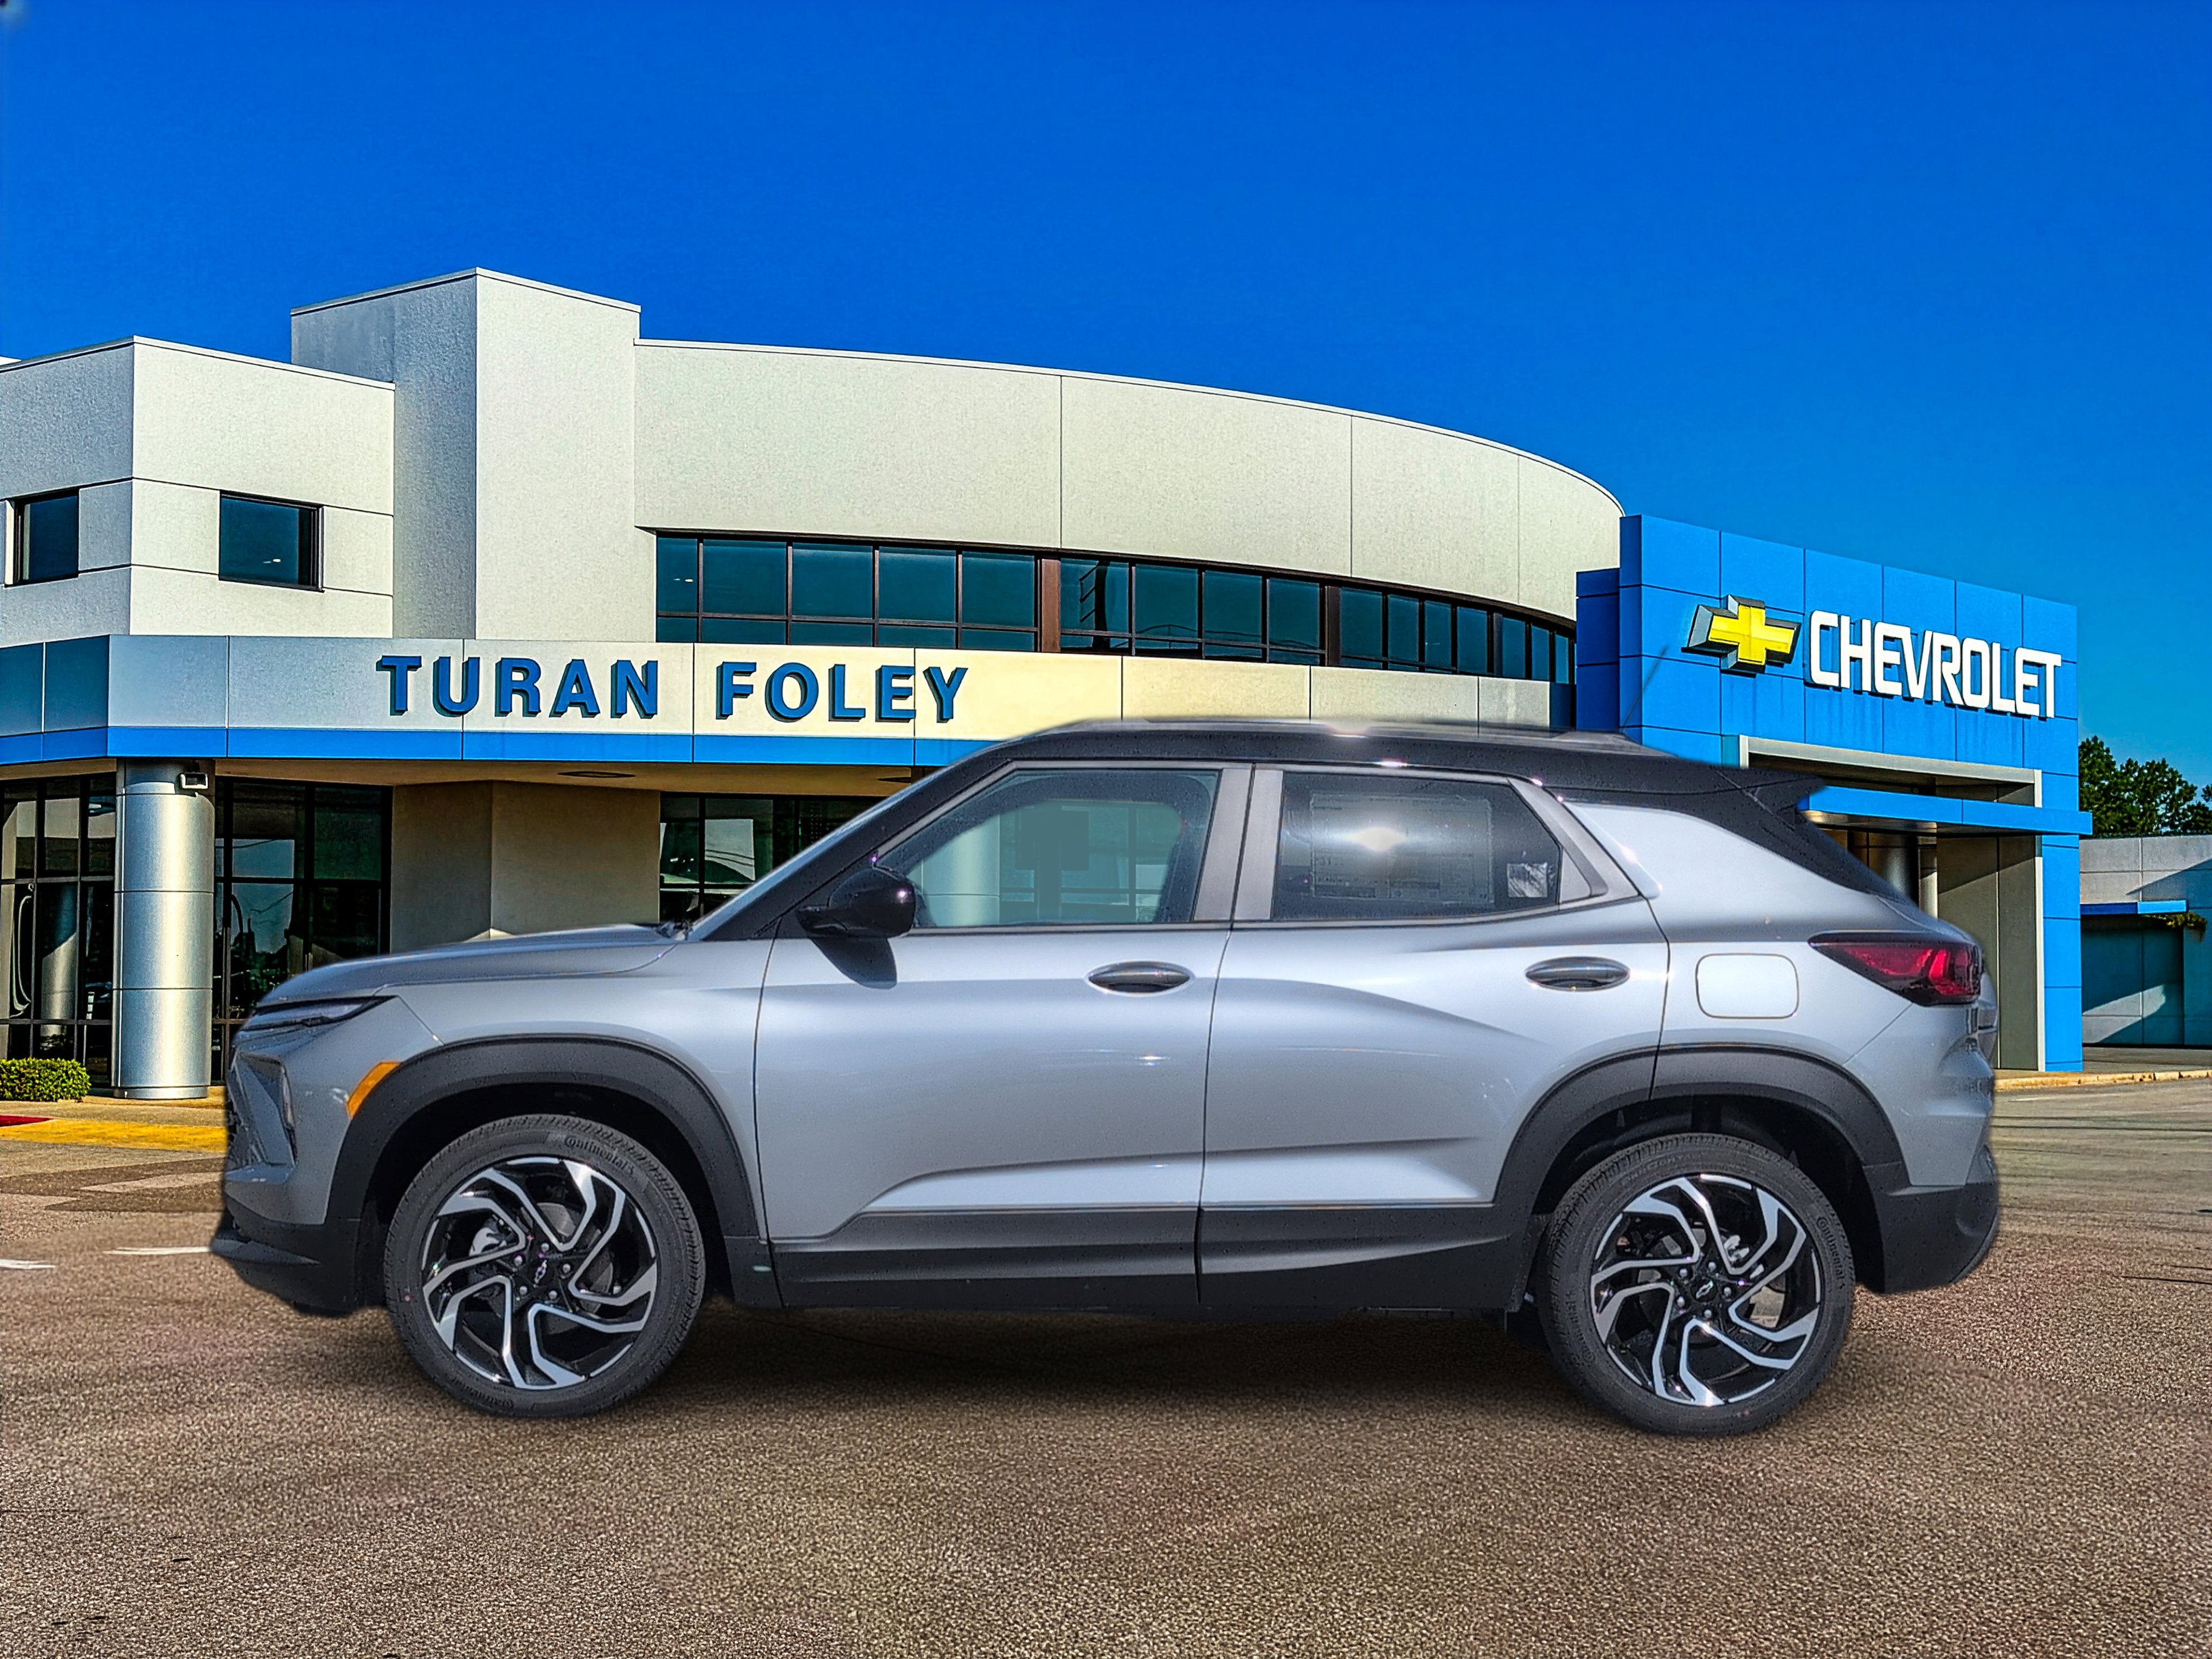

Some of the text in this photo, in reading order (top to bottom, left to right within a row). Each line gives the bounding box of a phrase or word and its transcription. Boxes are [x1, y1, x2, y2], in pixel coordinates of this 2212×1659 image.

[377, 655, 968, 723] TURAN FOLEY
[1810, 610, 2062, 718] CHEVROLET
[564, 1135, 628, 1170] Continental
[1817, 1216, 1845, 1278] Continental
